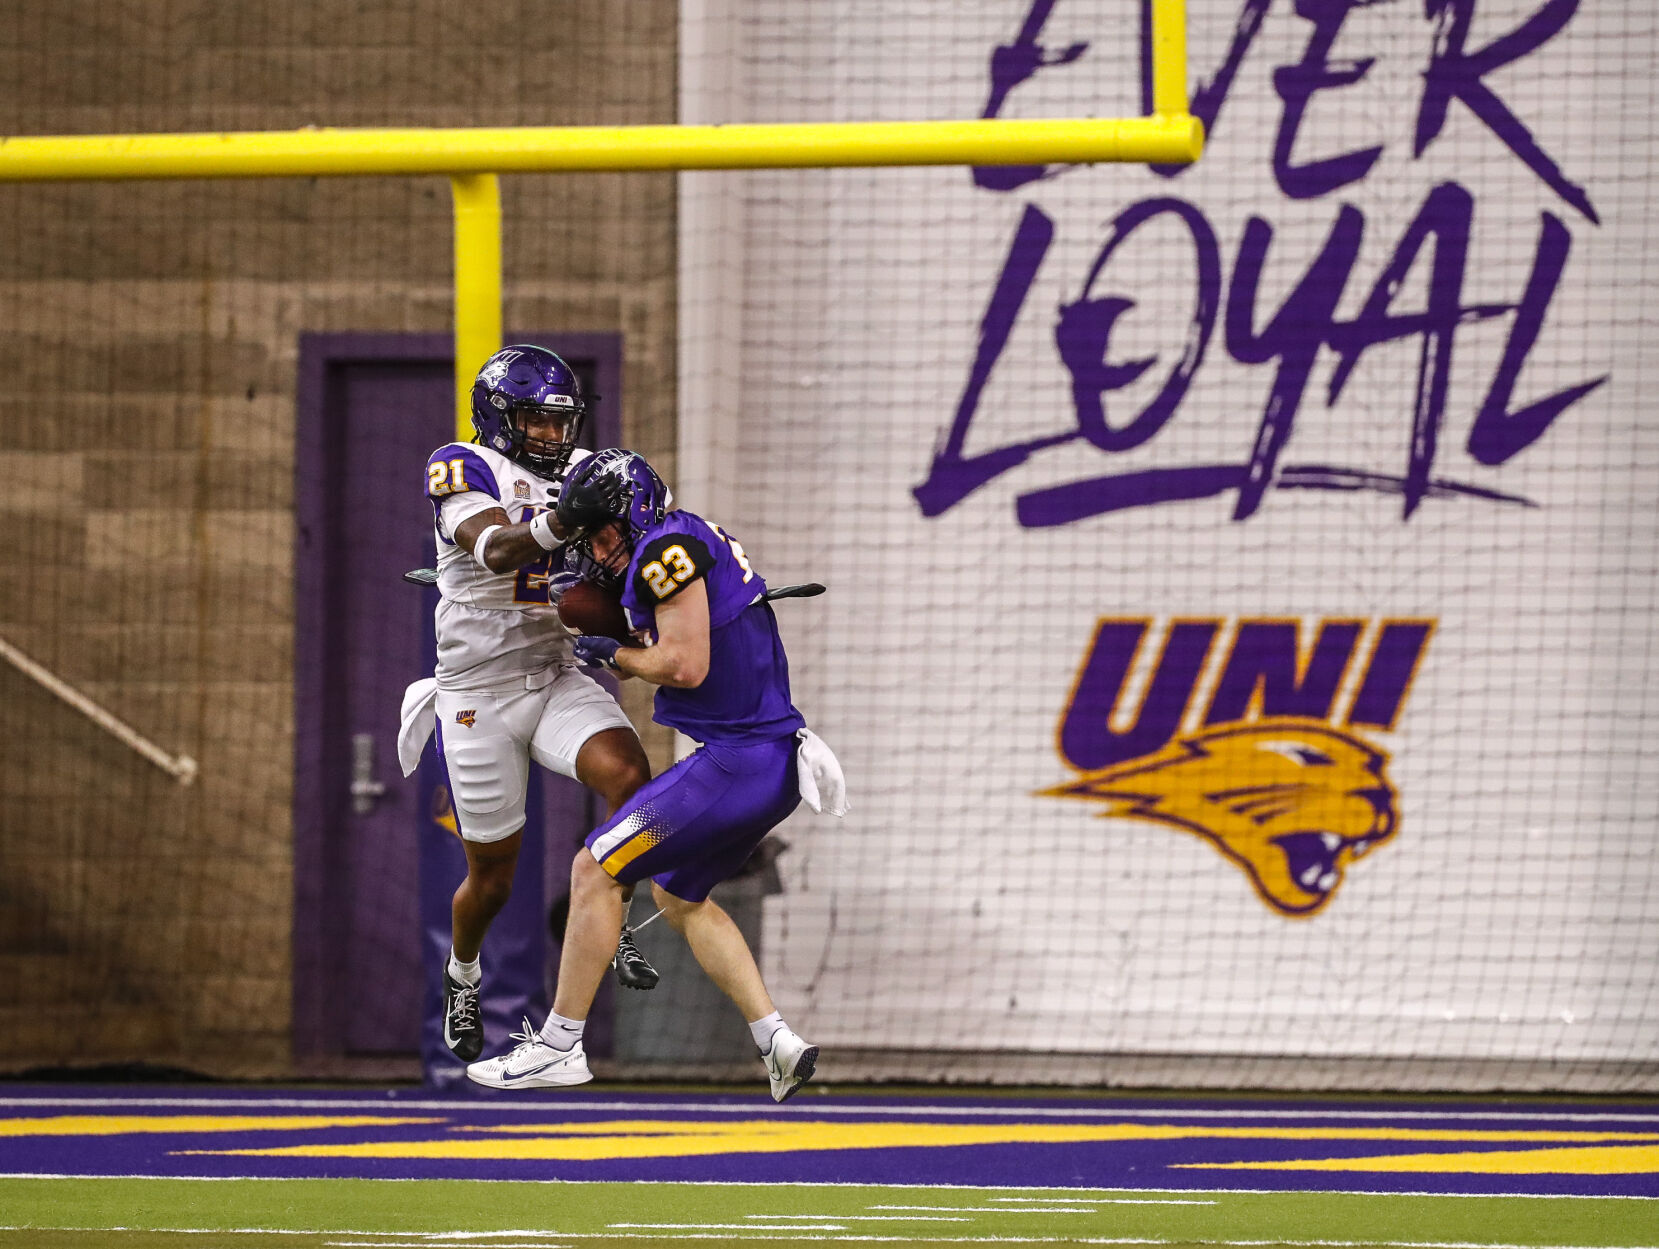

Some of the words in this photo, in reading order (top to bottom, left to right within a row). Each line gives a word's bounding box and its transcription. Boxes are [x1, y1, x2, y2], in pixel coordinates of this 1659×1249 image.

[911, 180, 1611, 525] LOYAL
[427, 459, 470, 497] 21
[641, 544, 696, 599] 23
[455, 709, 477, 722] UNI
[1055, 615, 1440, 773] UNI
